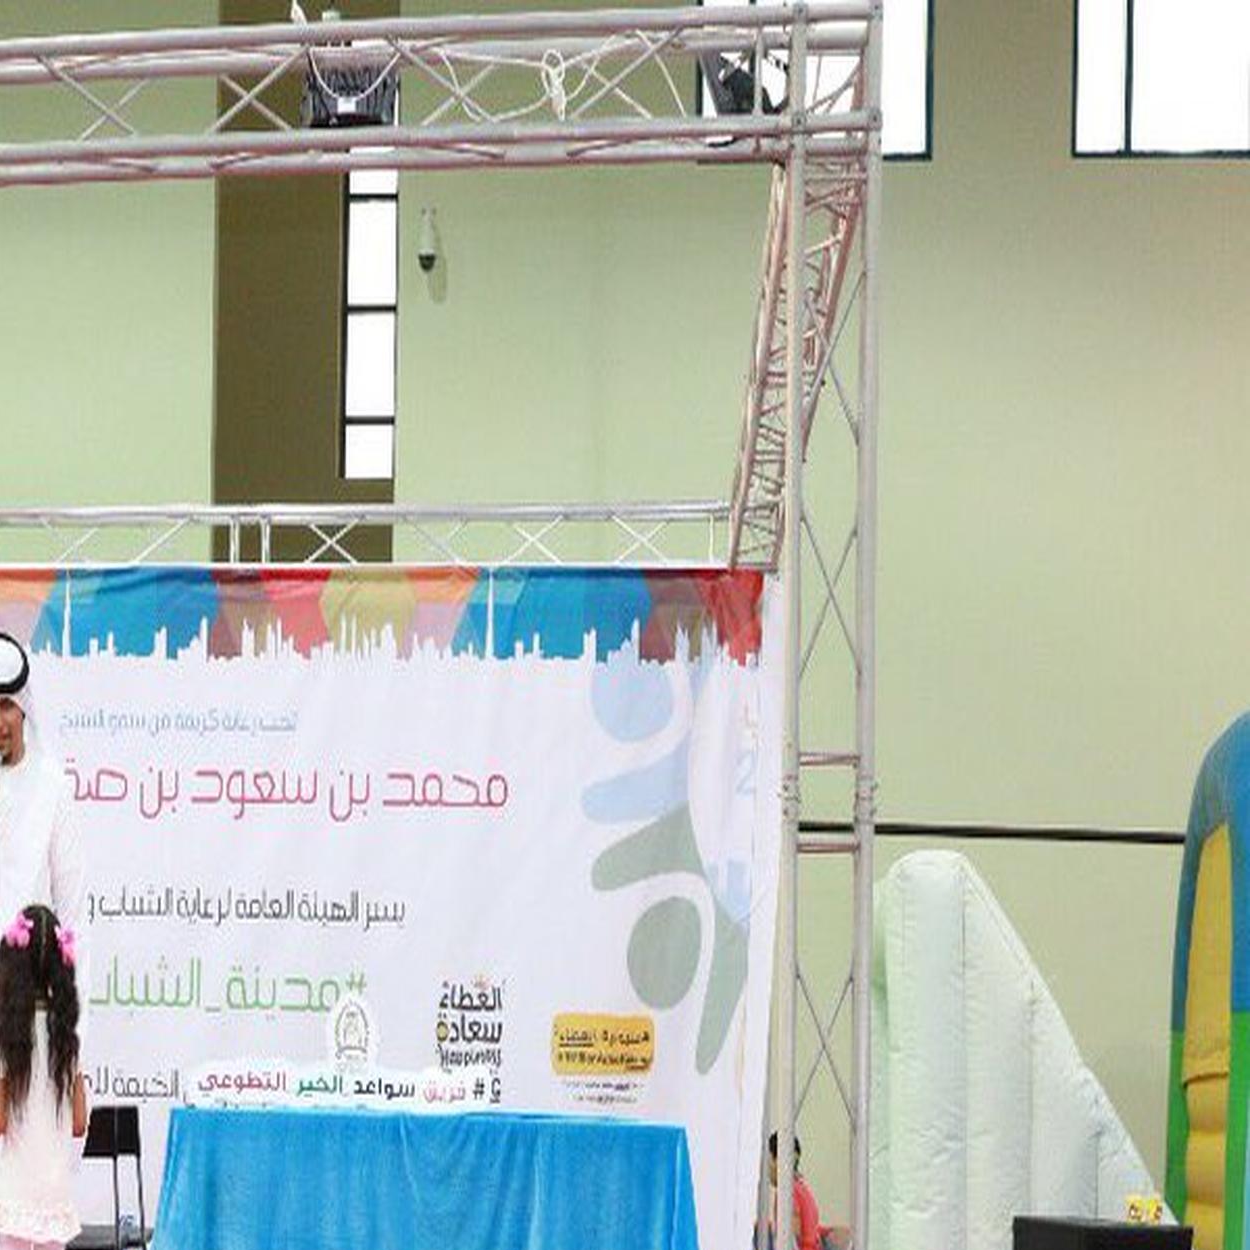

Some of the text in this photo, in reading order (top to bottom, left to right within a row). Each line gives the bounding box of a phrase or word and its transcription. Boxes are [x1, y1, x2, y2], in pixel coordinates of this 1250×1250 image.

[140, 766, 180, 819] بن
[191, 769, 318, 820] سعود
[330, 769, 371, 822] بن
[383, 772, 508, 807] محمد
[235, 889, 295, 920] العامة
[439, 981, 503, 1011] العطاء
[436, 1011, 502, 1043] سعادة
[197, 1071, 286, 1098] التطوعي
[296, 1073, 343, 1098] الخير
[353, 1077, 416, 1101] سواعد
